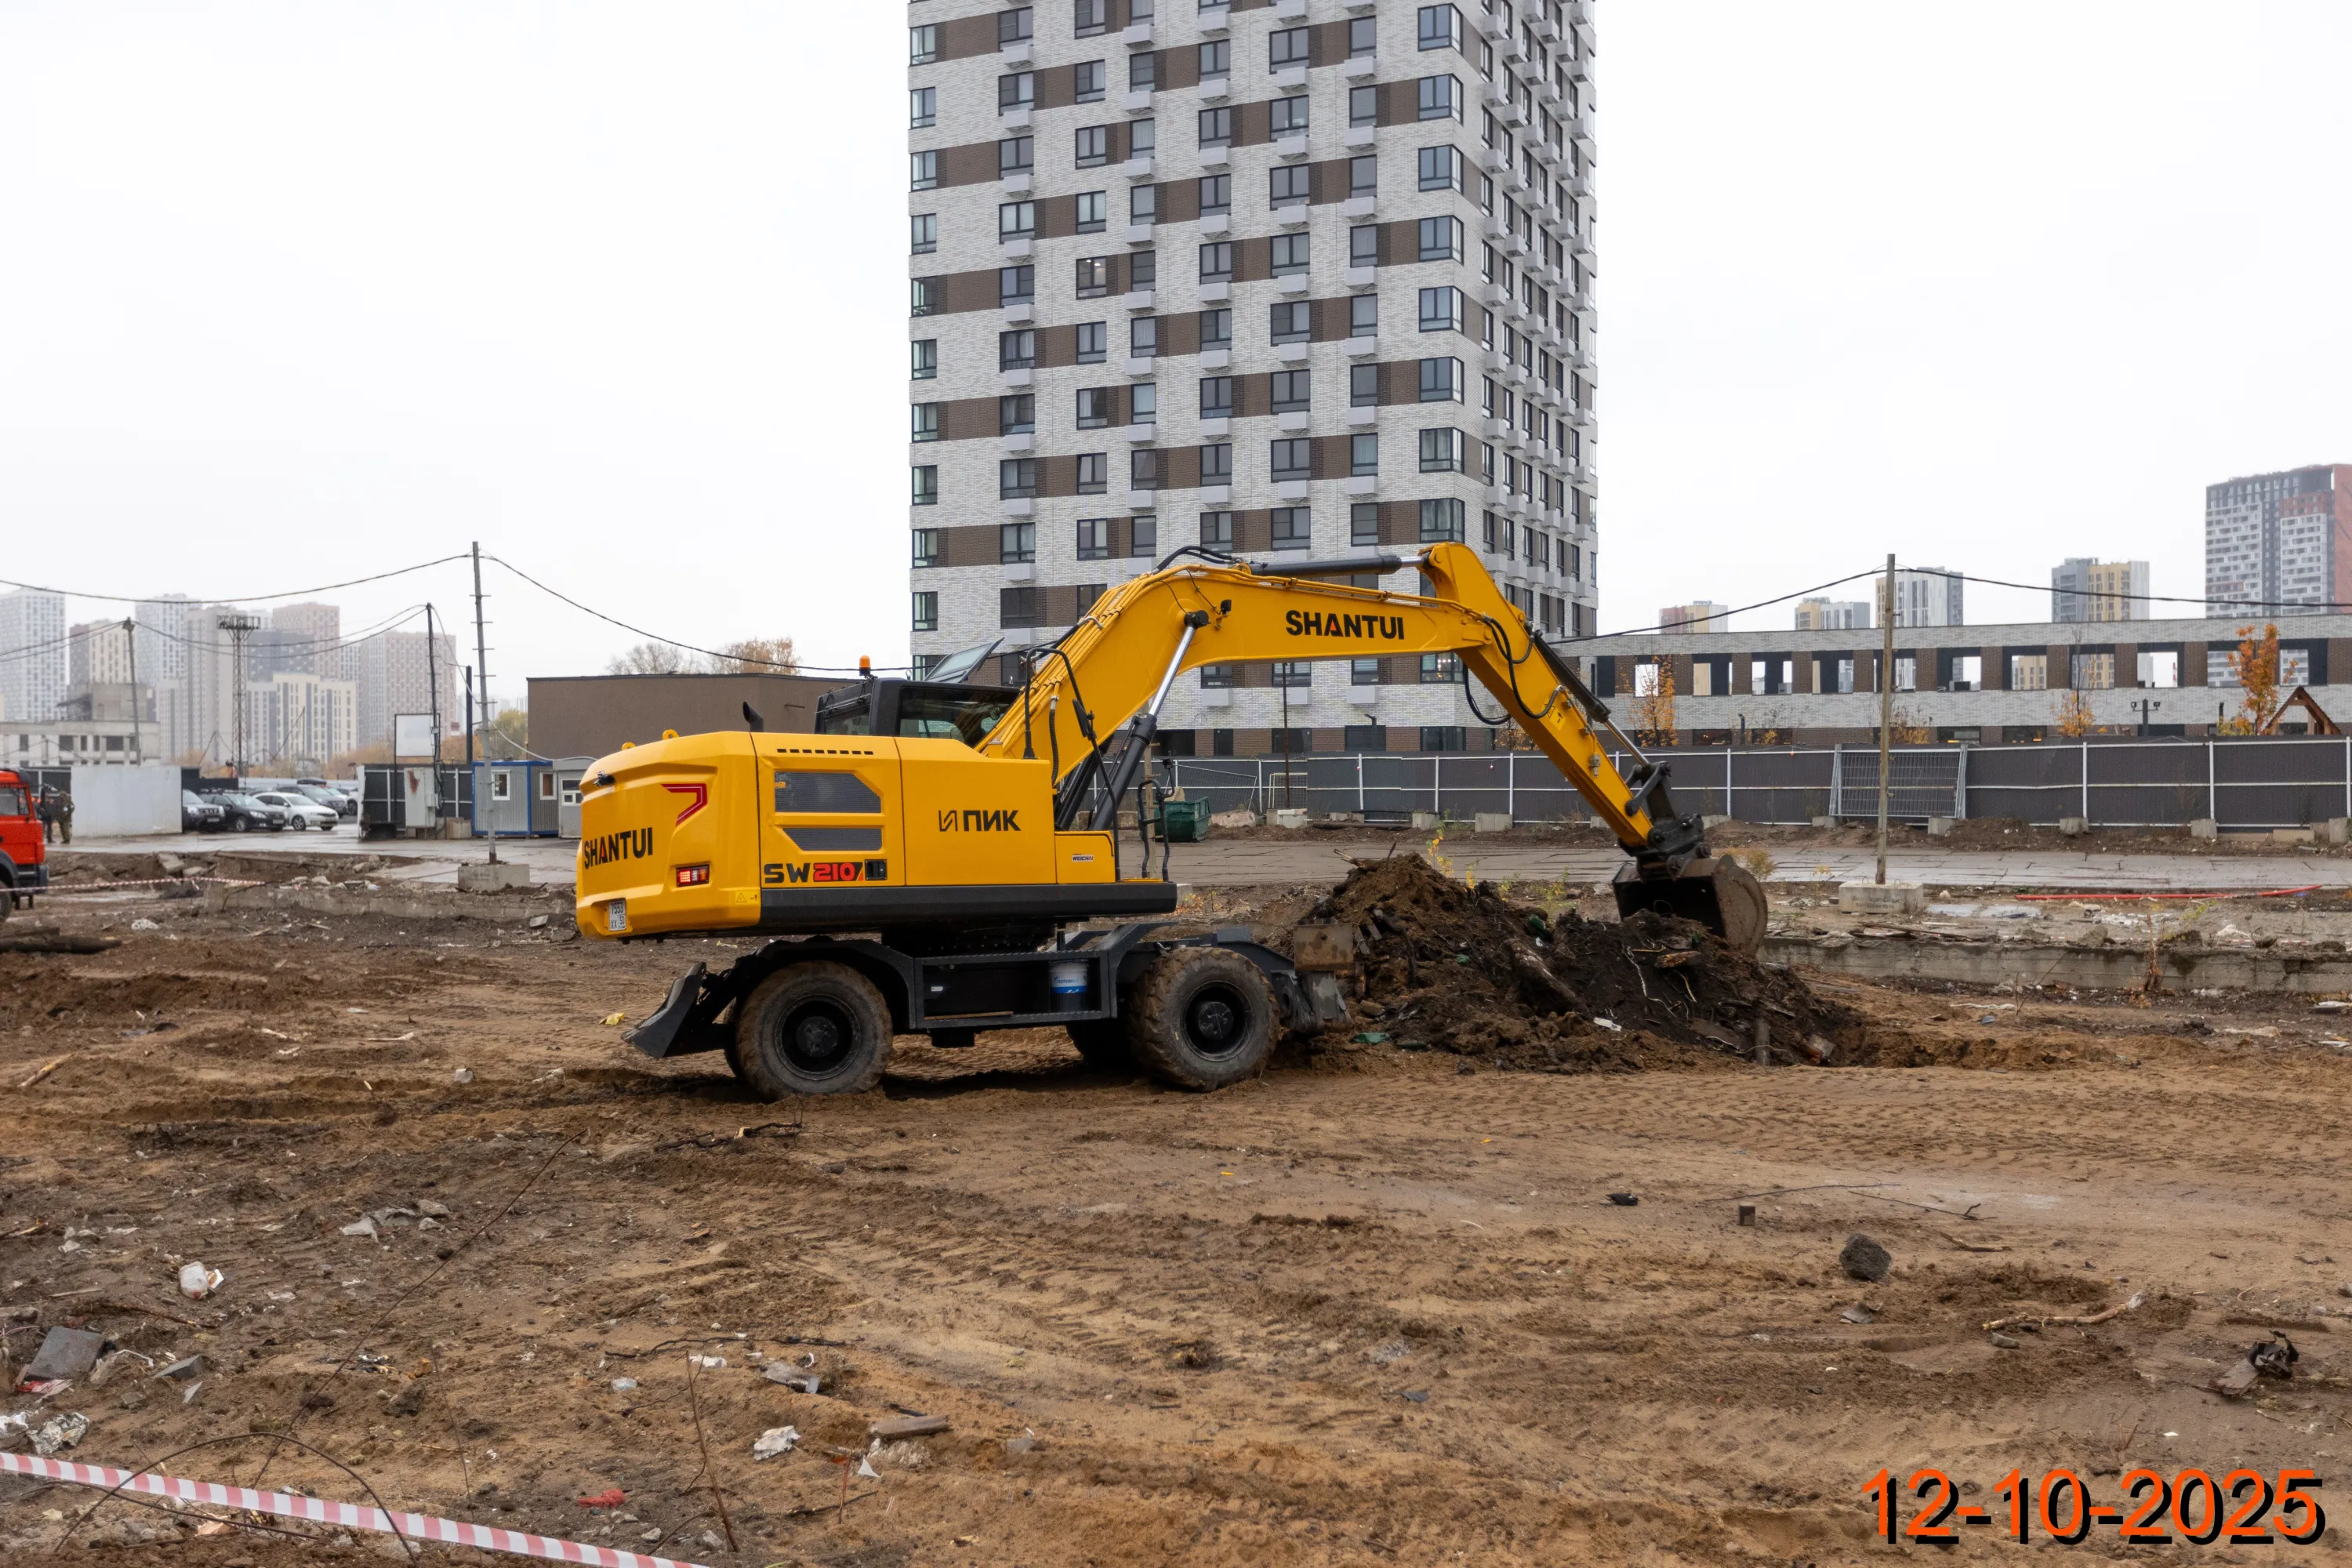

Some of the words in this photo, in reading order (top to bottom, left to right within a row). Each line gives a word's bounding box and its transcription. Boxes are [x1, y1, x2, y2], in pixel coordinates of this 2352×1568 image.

[1286, 610, 1405, 640] SHANTUI
[963, 810, 1022, 832] ПИК
[584, 827, 653, 869] SHANTUI
